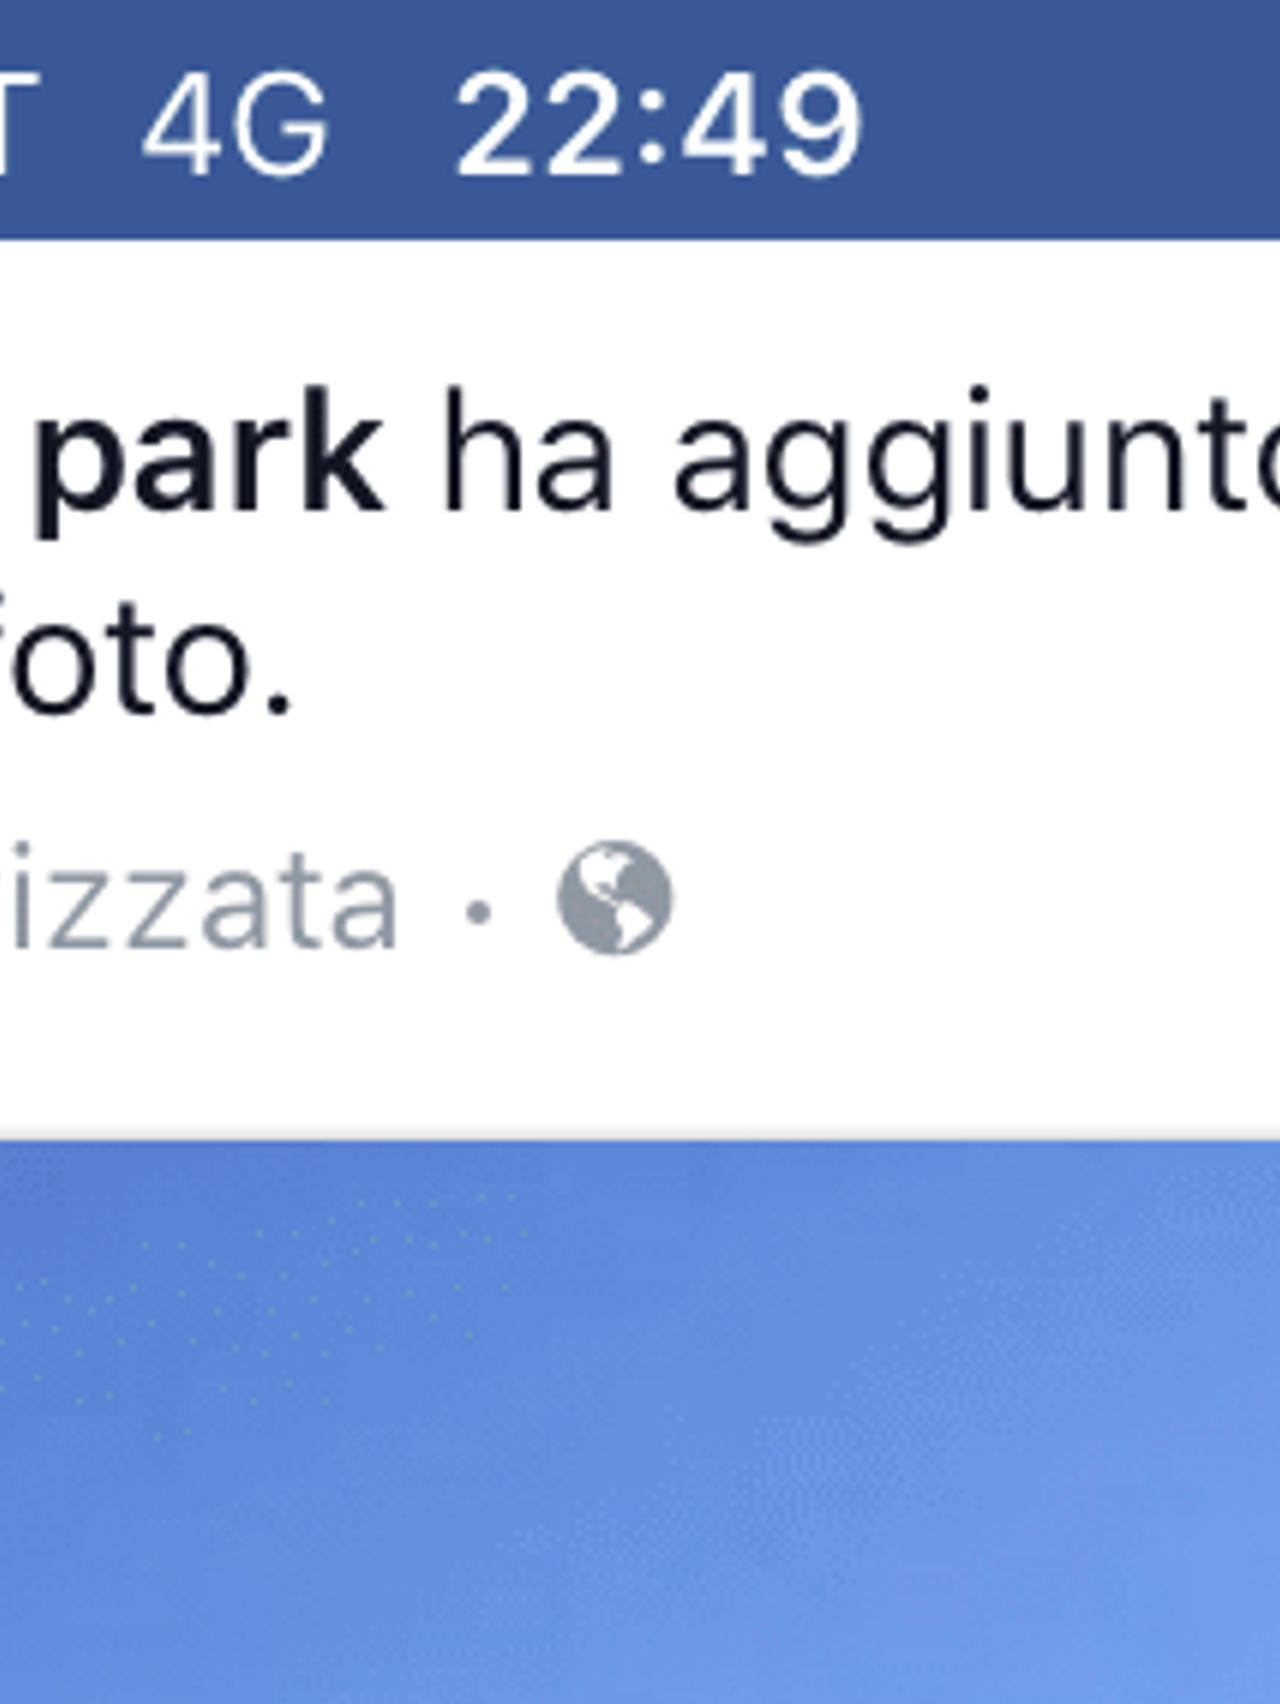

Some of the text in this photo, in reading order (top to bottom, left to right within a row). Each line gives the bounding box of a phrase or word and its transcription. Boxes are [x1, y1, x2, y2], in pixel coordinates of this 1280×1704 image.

[141, 70, 328, 179] 4G
[456, 69, 863, 179] 22:49
[33, 382, 388, 544] park
[444, 382, 613, 515] ha
